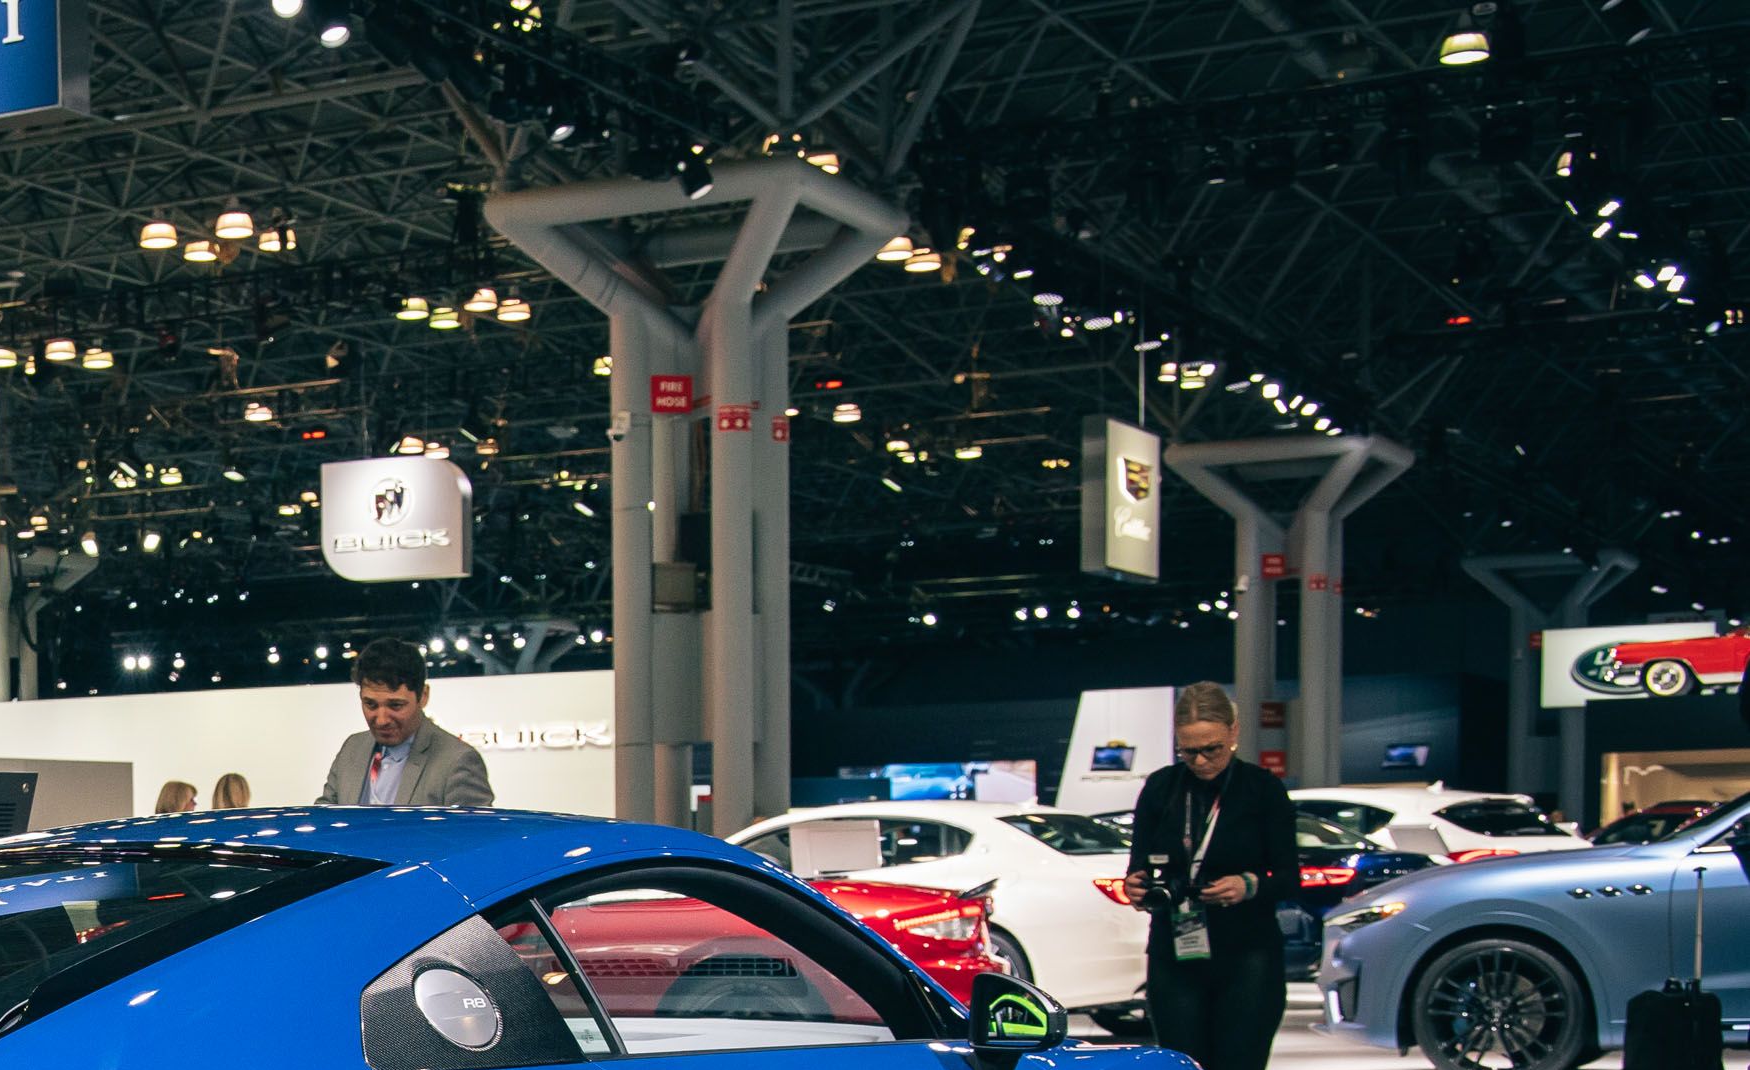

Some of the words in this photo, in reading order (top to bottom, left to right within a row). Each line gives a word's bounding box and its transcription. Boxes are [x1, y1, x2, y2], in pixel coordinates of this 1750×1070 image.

[659, 381, 683, 392] FIRE
[656, 396, 687, 407] HOSE
[334, 528, 450, 553] BUICK
[459, 720, 613, 751] BUICK
[463, 998, 487, 1009] R8
